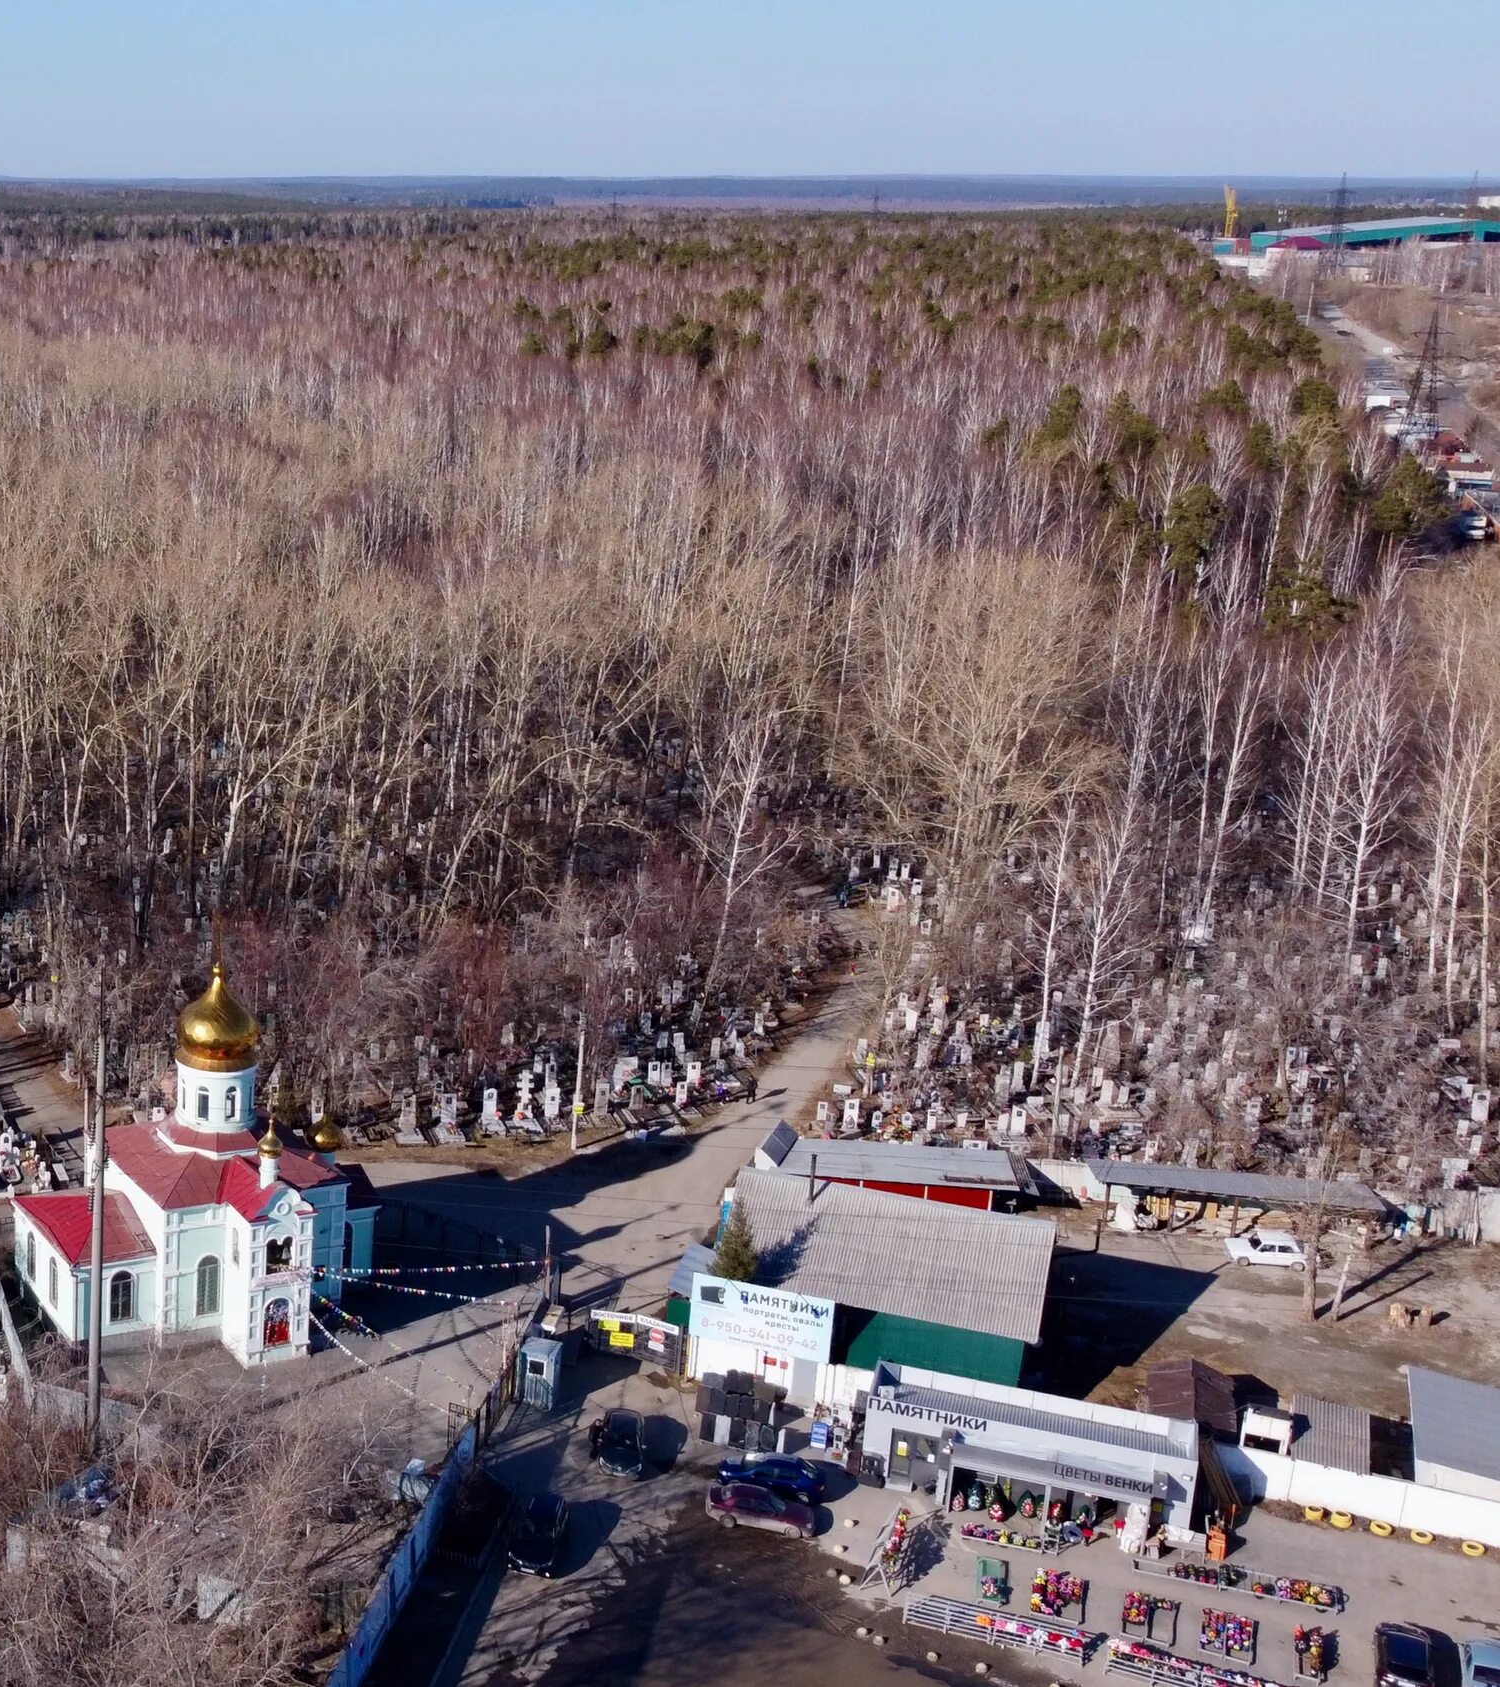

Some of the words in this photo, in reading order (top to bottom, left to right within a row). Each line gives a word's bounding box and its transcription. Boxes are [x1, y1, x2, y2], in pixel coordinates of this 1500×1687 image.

[740, 1290, 829, 1318] ПАМЯТНИКИ
[701, 1317, 818, 1350] 8-950-541-09-42
[764, 1320, 799, 1332] кресты
[868, 1397, 988, 1432] ПАМЯТНИКИ
[1054, 1464, 1101, 1482] ЦВЕТЫ
[1104, 1474, 1154, 1495] ВЕНКИ
